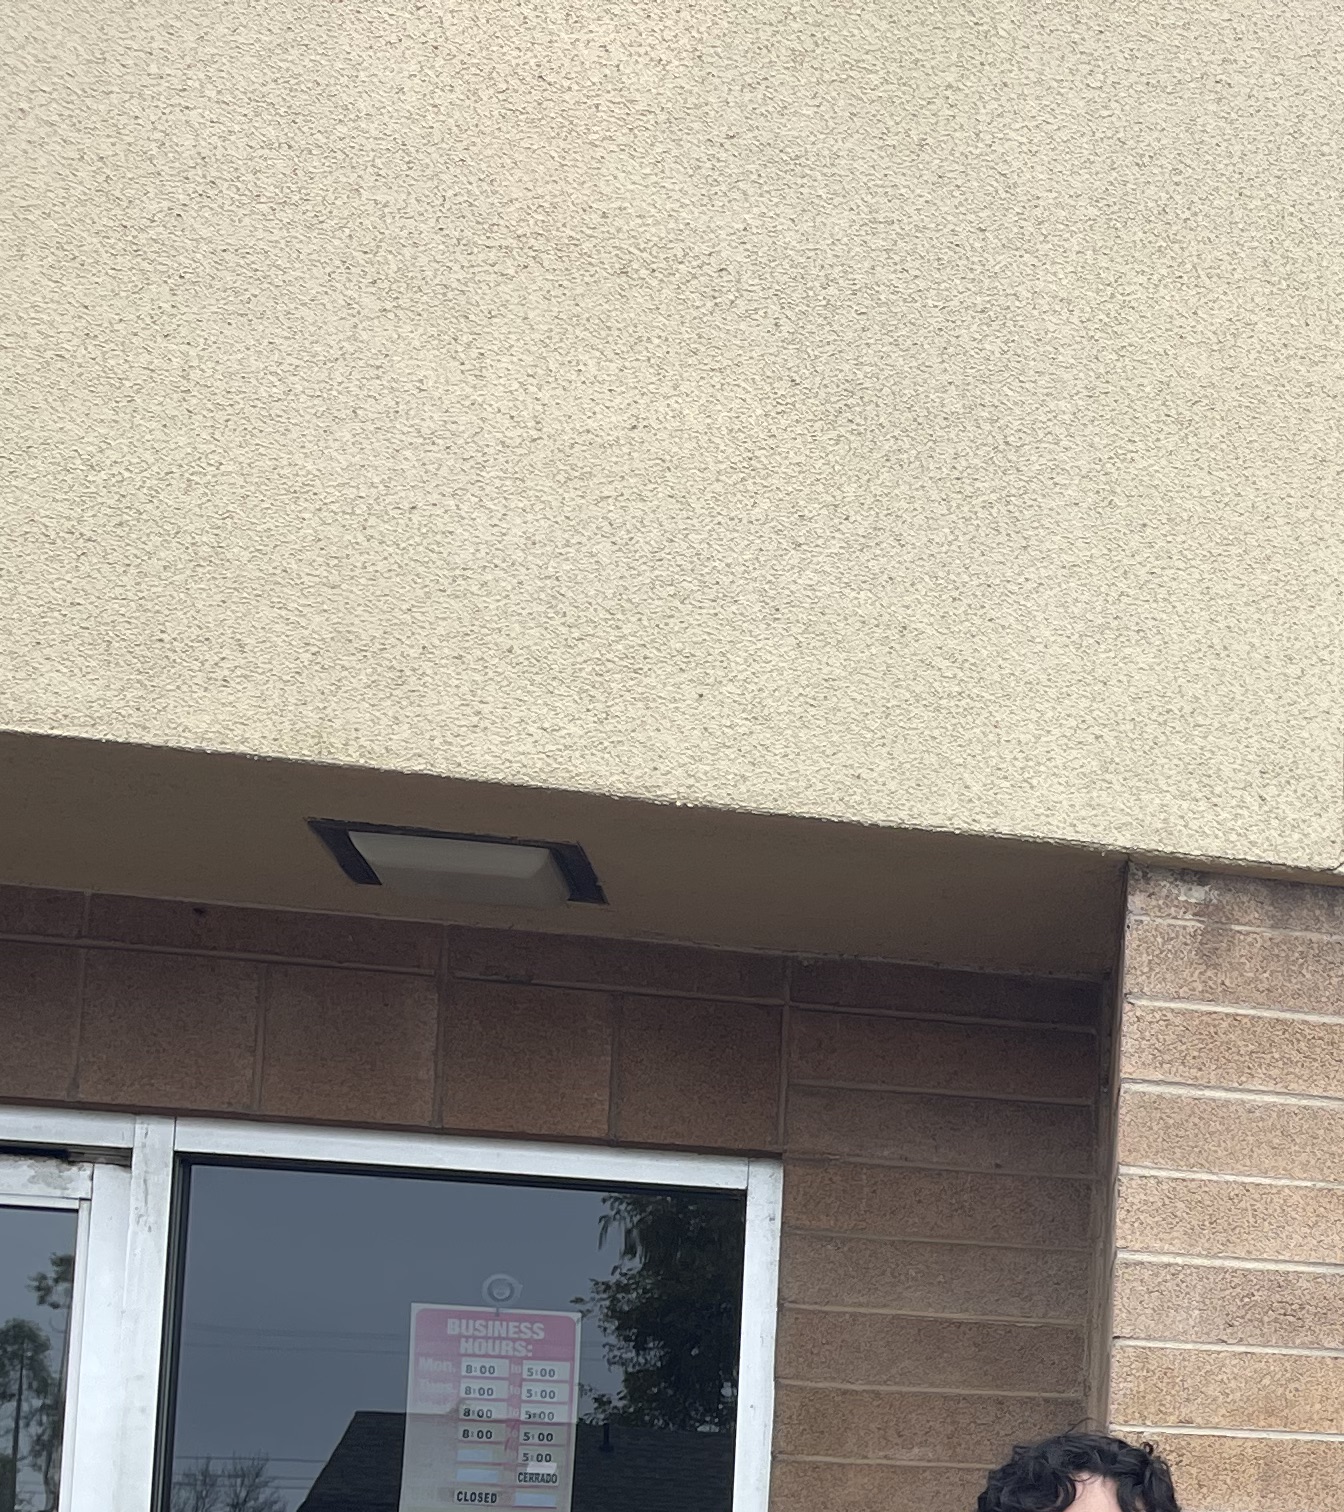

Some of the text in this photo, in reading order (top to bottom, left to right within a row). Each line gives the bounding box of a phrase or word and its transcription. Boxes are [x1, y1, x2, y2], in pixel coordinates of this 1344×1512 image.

[447, 1318, 545, 1340] BUSINESS
[459, 1338, 533, 1357] HOURS:
[464, 1364, 496, 1375] 8:00
[526, 1367, 556, 1378] 5:00
[463, 1386, 494, 1397] 8:00
[525, 1389, 556, 1400] 5:00
[462, 1408, 493, 1419] 8:00
[524, 1411, 555, 1422] 5:00
[462, 1430, 493, 1440] 8:00
[523, 1432, 554, 1443] 5:00
[522, 1453, 552, 1463] 5:00
[517, 1472, 558, 1484] CERRADO
[456, 1491, 498, 1504] CLOSED
